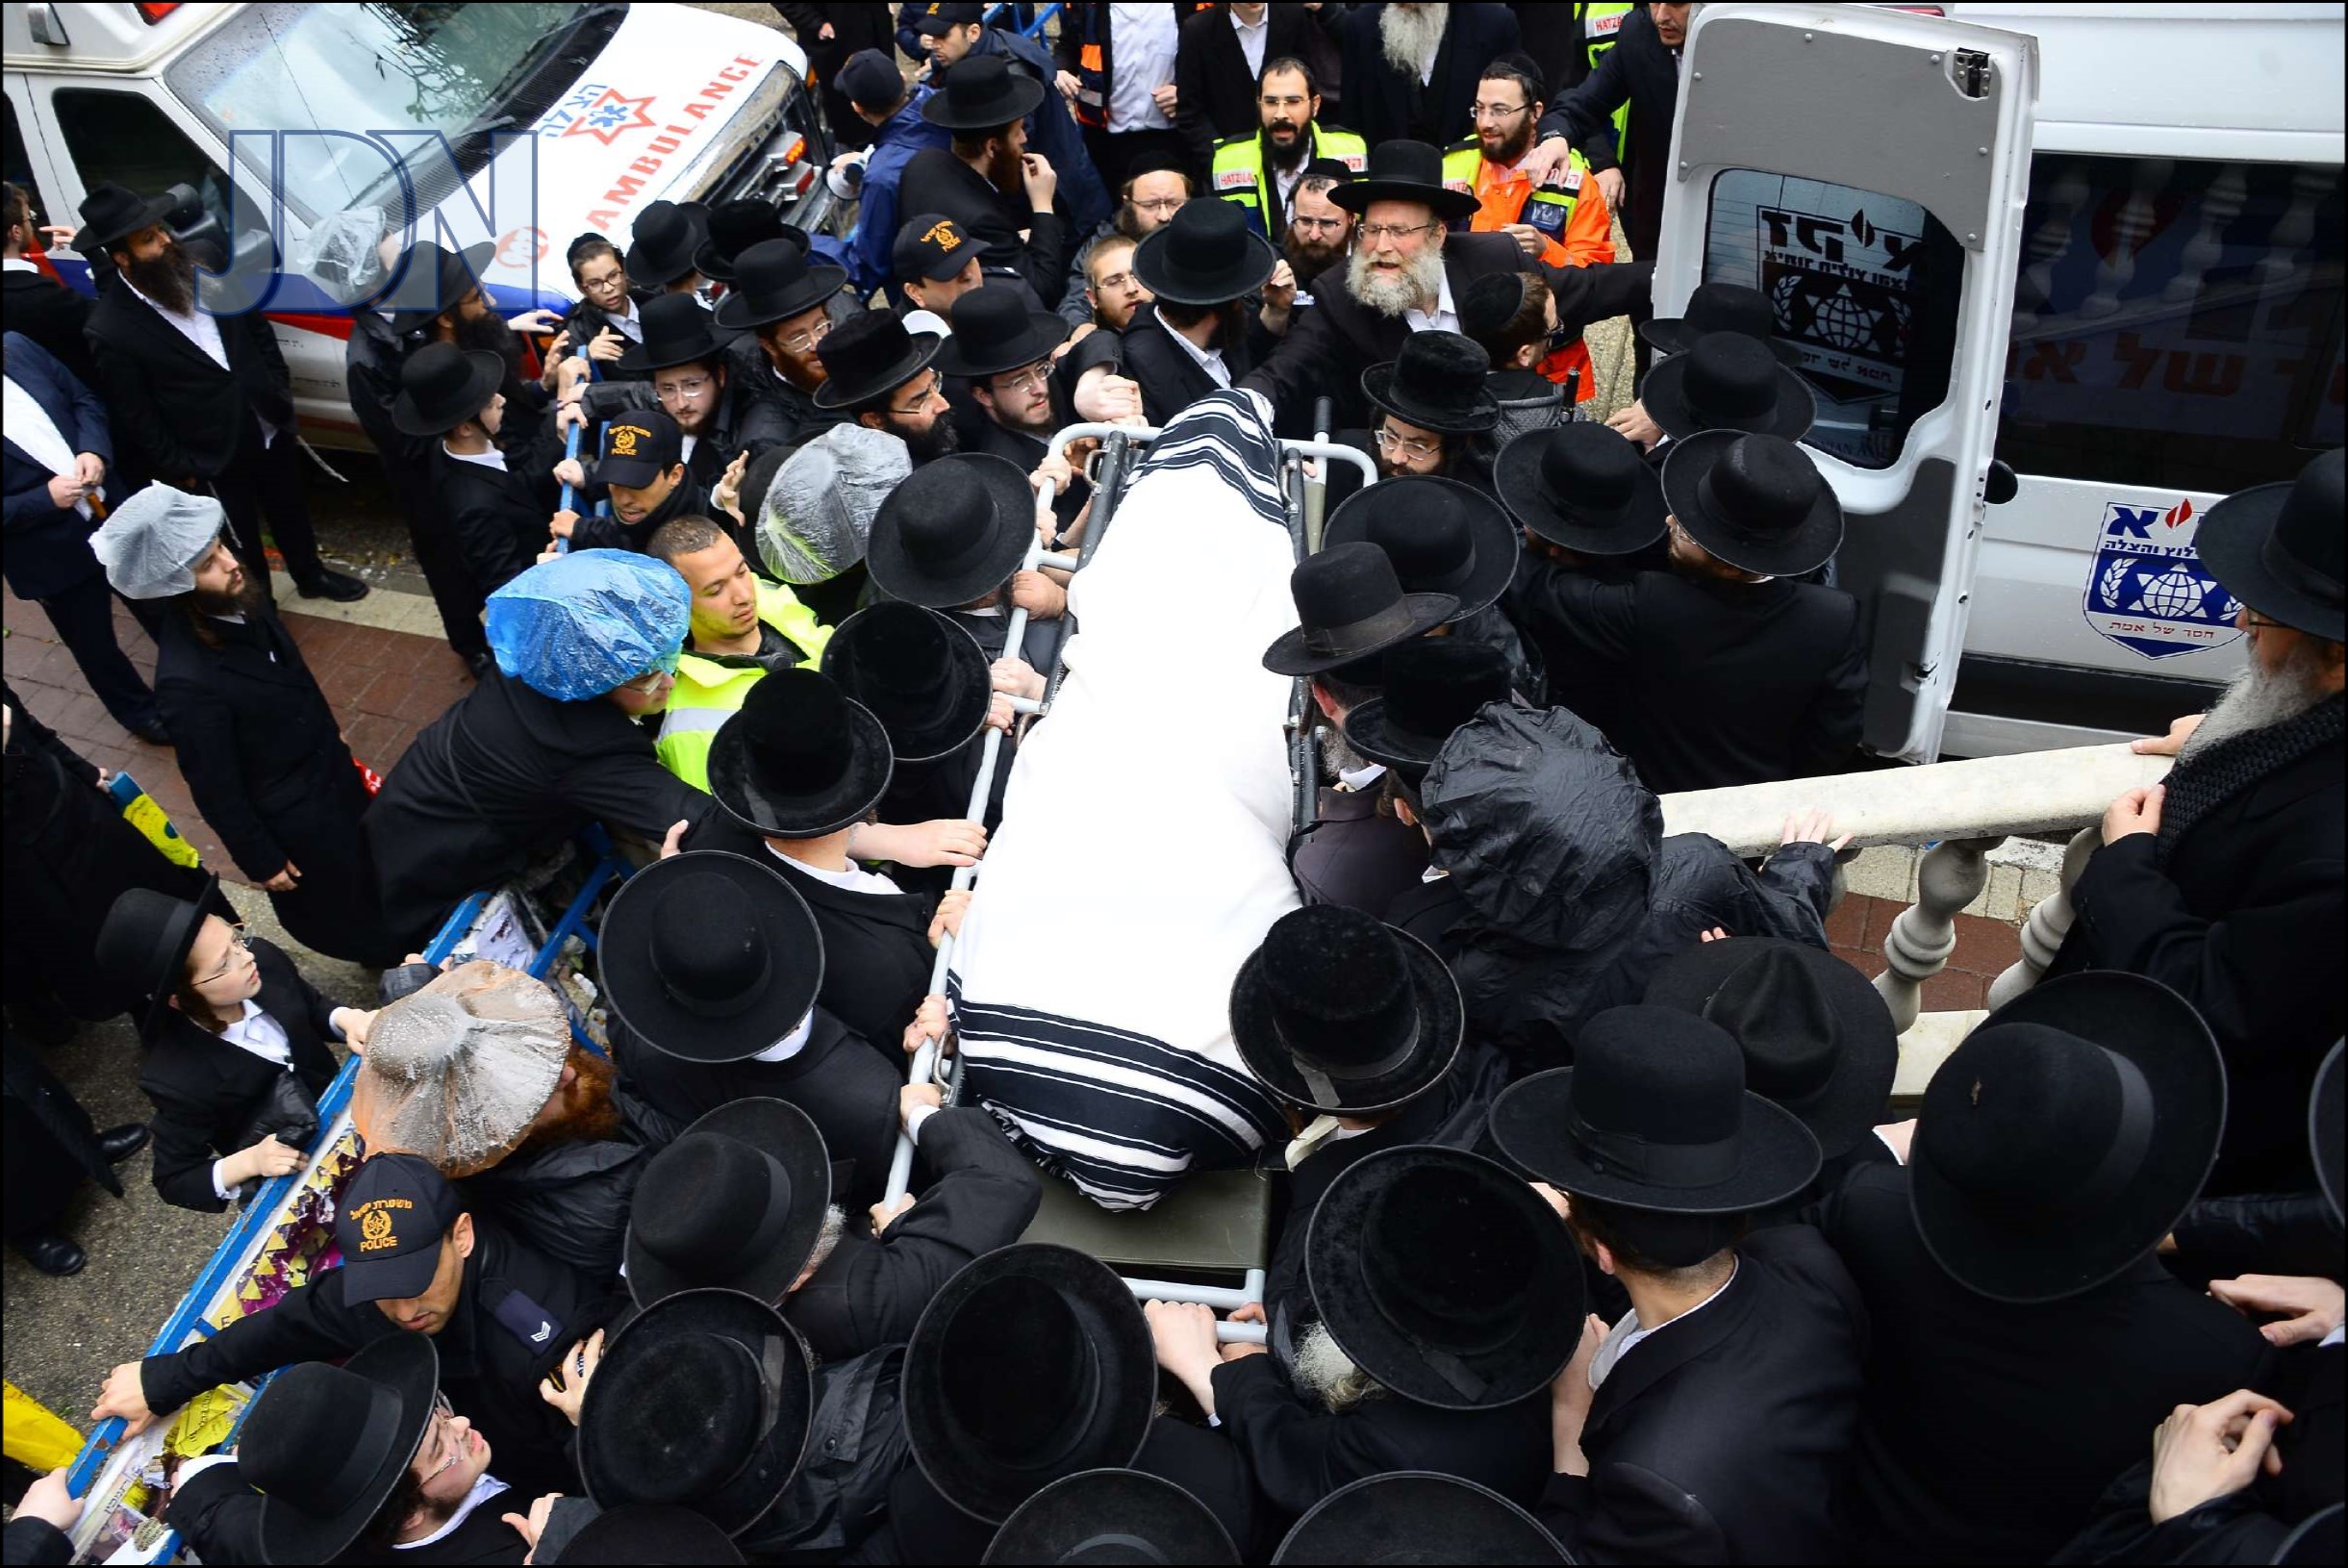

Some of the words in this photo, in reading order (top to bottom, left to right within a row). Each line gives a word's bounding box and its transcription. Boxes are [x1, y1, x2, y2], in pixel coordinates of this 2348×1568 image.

[537, 83, 608, 138] הצלה
[586, 53, 765, 232] AMBULANCE
[2104, 539, 2159, 555] והצלה
[2108, 620, 2145, 633] אמת
[2152, 621, 2175, 635] של
[2184, 628, 2215, 639] חסד
[359, 1235, 399, 1252] POLICE
